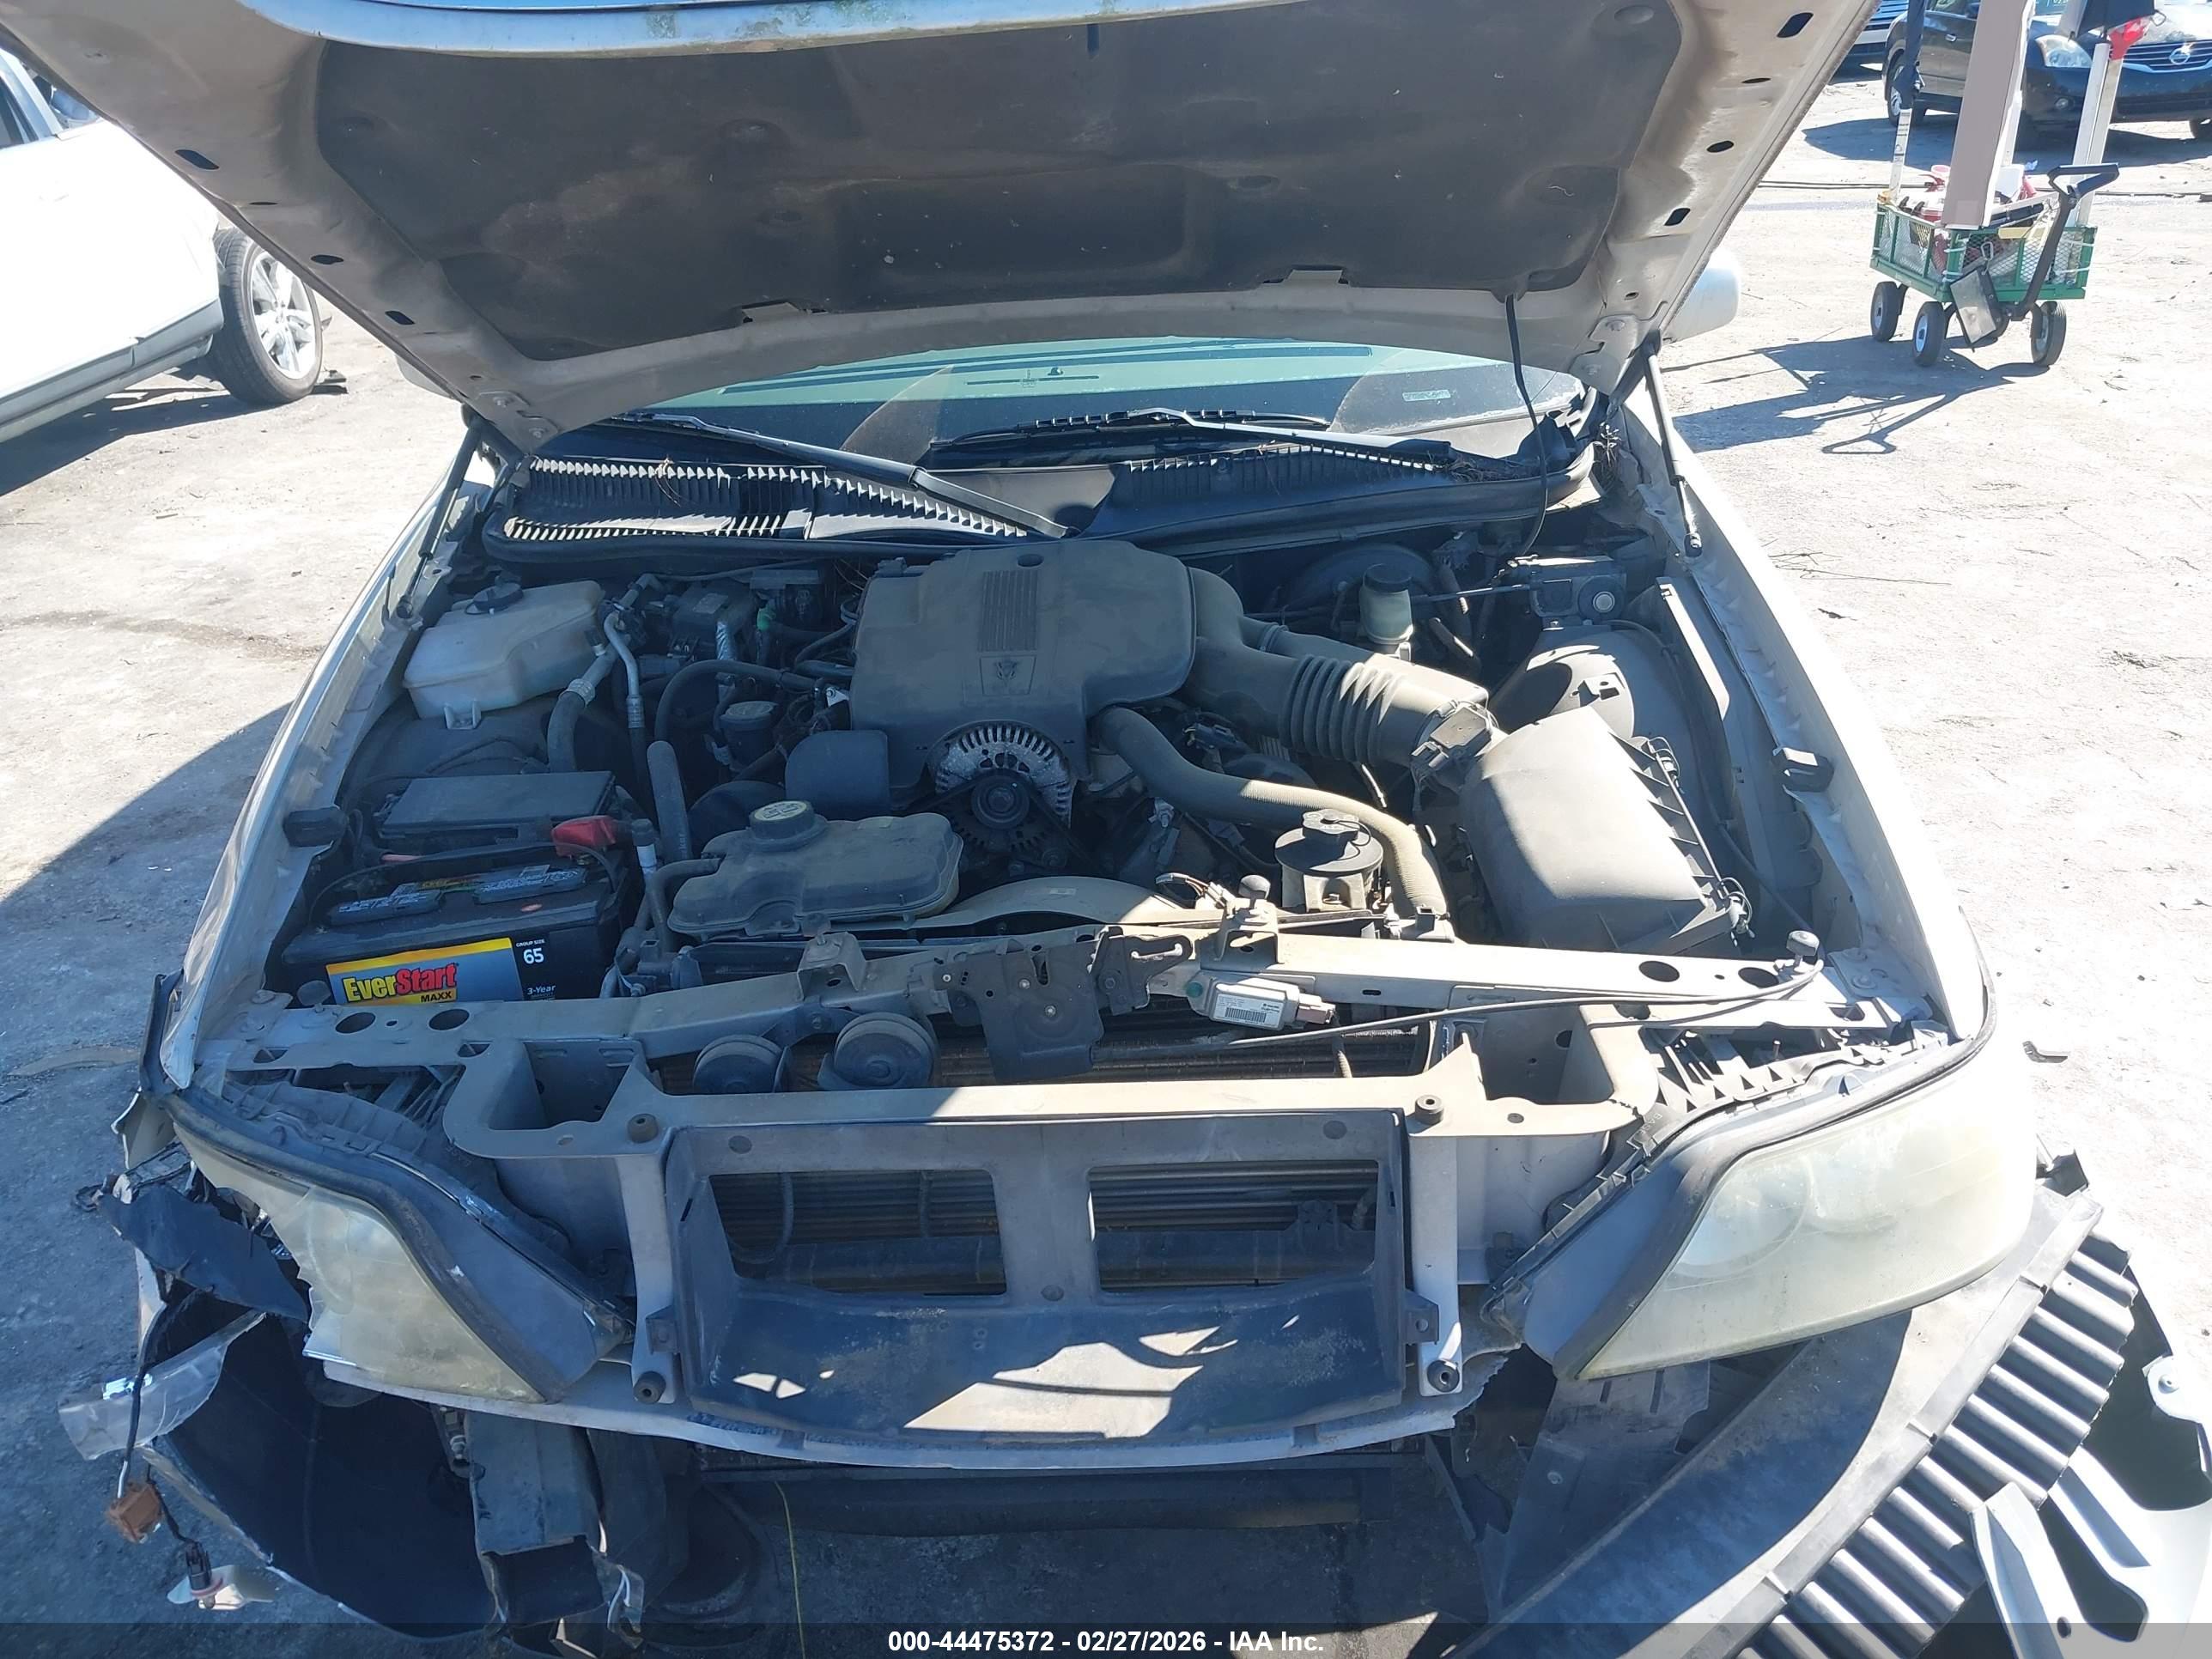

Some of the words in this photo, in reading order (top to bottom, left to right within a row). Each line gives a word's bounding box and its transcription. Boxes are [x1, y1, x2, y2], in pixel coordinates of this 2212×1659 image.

[523, 947, 544, 964] 65
[343, 962, 457, 1003] EverStart
[420, 991, 453, 1003] MAXX
[526, 985, 556, 995] 3-Year
